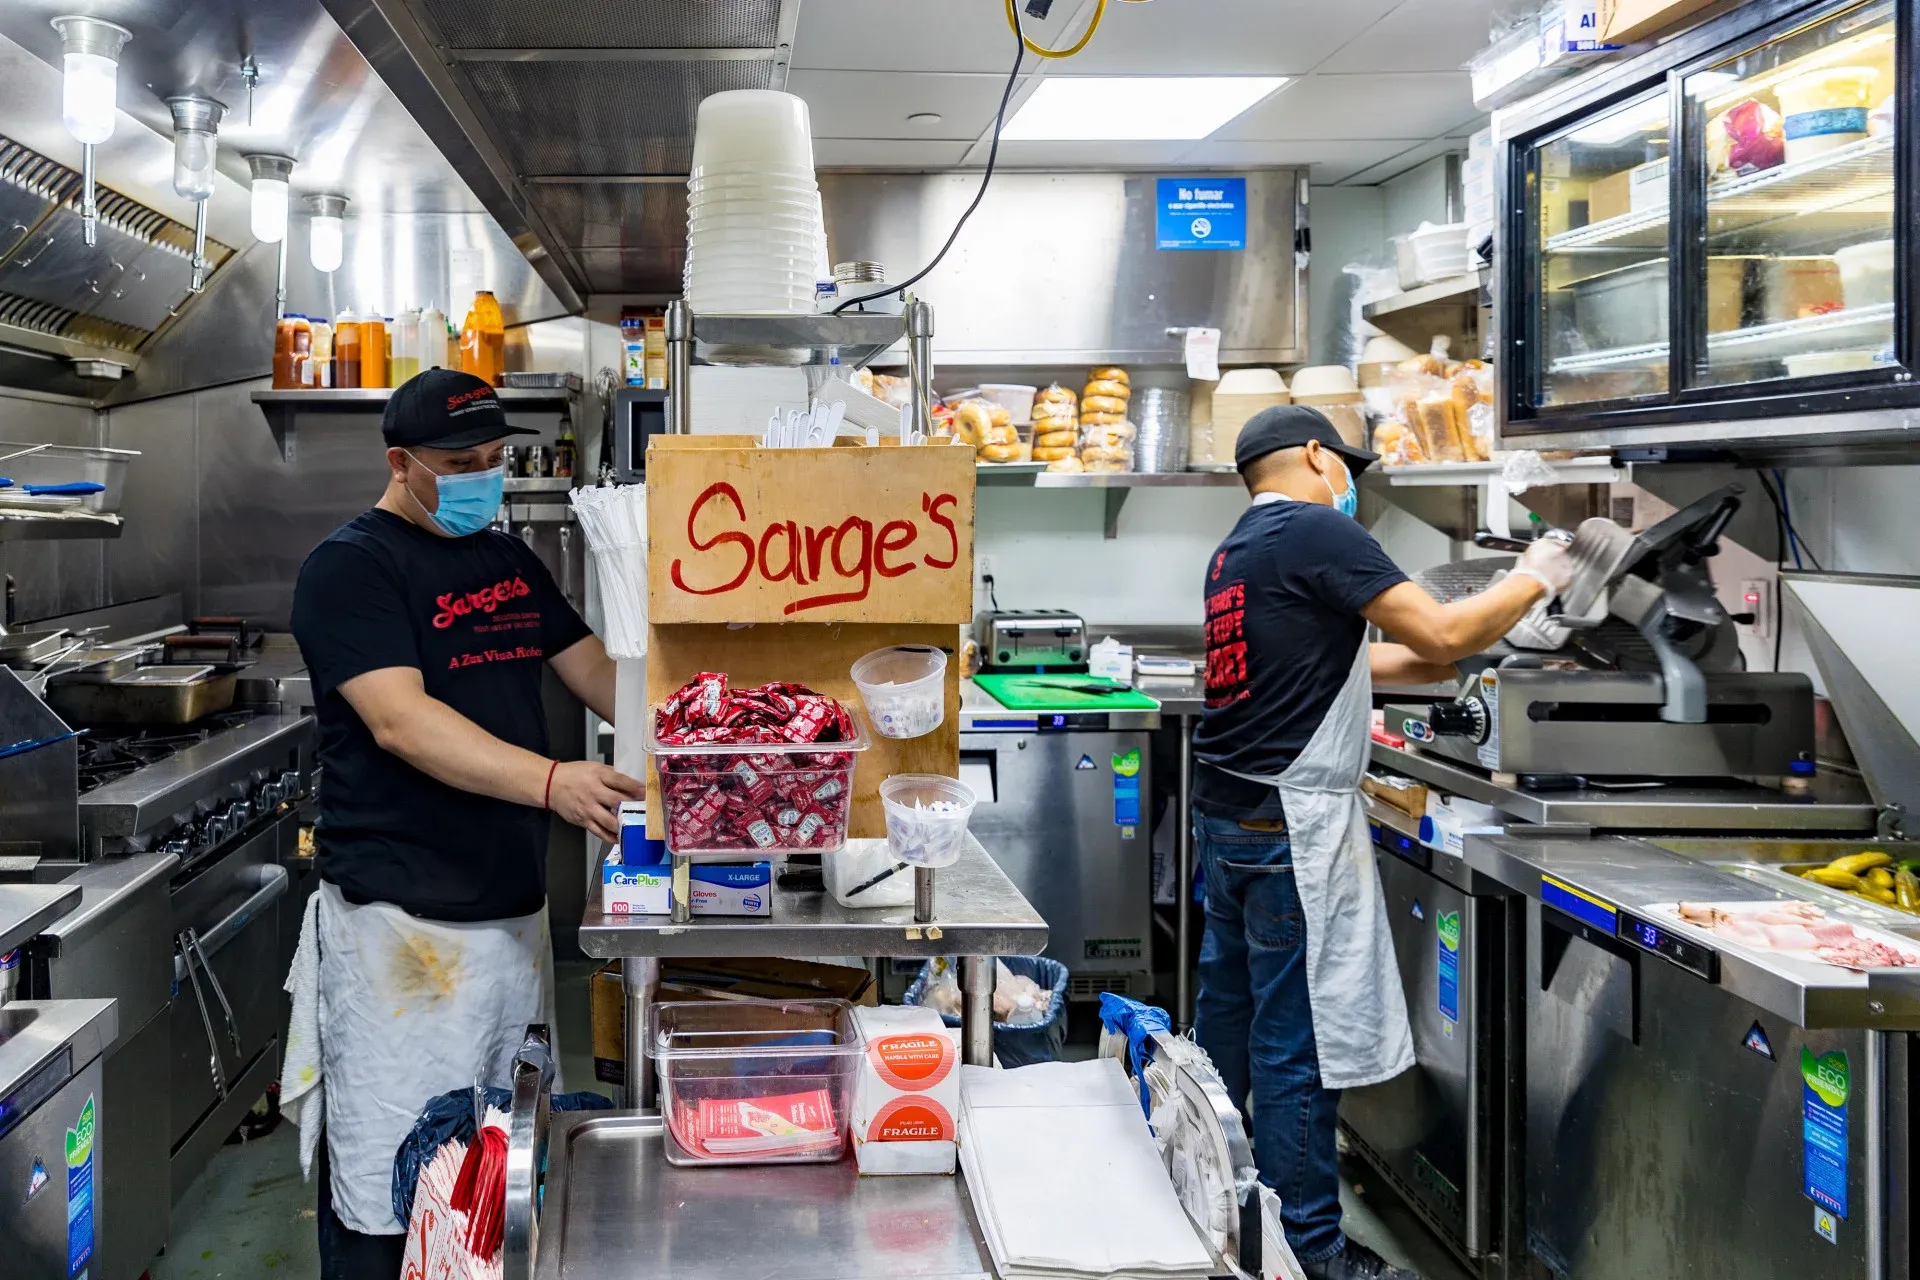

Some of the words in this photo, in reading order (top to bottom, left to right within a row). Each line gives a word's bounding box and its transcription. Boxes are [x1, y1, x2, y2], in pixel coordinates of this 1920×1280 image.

[1179, 188, 1193, 201] No
[1194, 188, 1224, 201] fumar
[671, 482, 958, 615] Sarge's
[614, 874, 659, 886] CarePlus
[692, 890, 718, 898] Gloves
[612, 904, 628, 912] 100
[1643, 926, 1656, 945] 33
[882, 1040, 938, 1051] FRAGILE
[1818, 1065, 1846, 1090] ECO
[1806, 1072, 1847, 1099] FRIENDLY
[76, 1121, 93, 1147] ECO
[883, 1126, 938, 1137] FRAGILE
